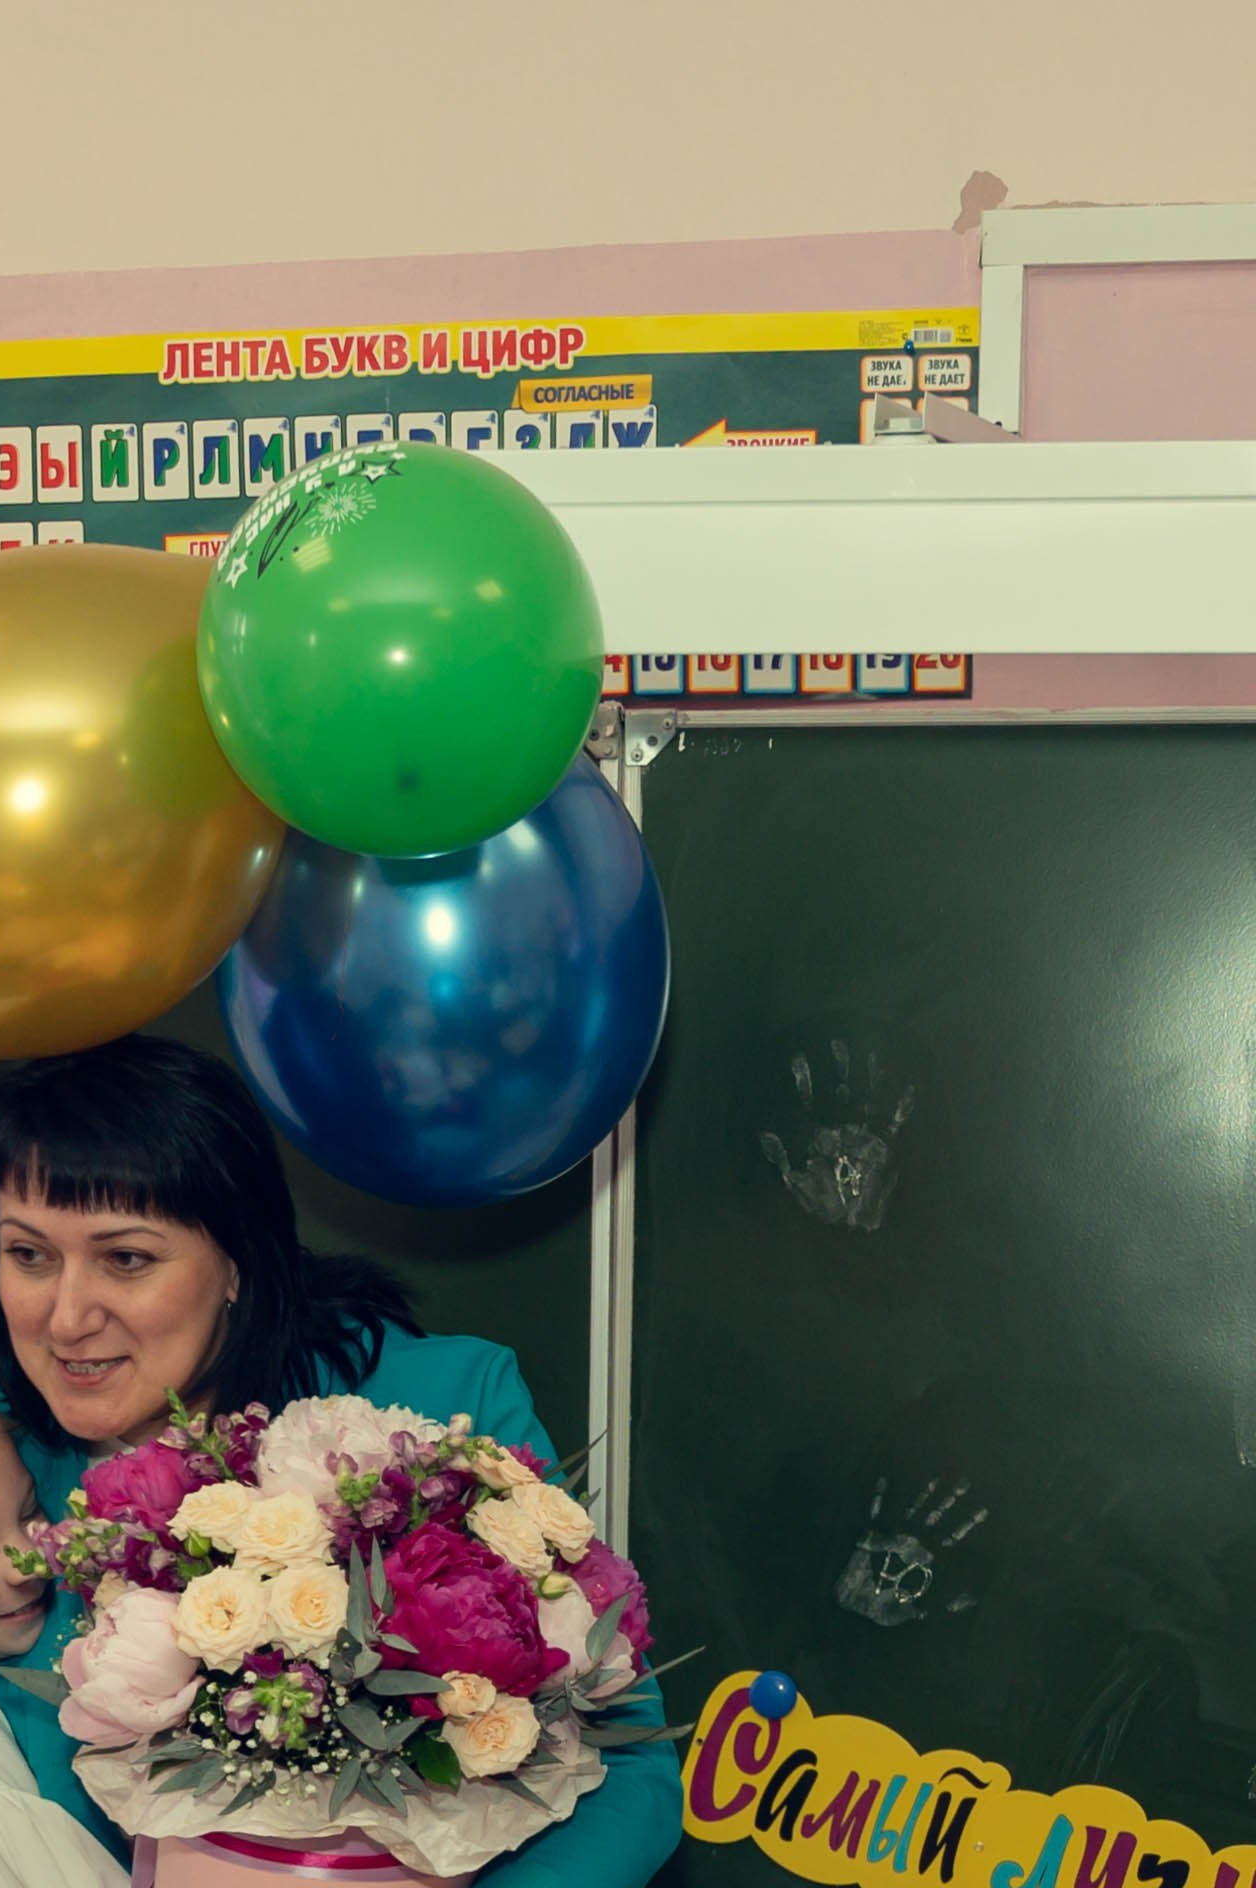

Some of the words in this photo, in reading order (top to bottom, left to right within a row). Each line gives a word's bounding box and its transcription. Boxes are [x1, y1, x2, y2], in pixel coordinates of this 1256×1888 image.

[162, 340, 292, 380] ЛЕНТА
[305, 334, 408, 375] БУКВ
[422, 332, 448, 369] И
[462, 328, 584, 374] ЦИФР
[871, 360, 902, 371] ЗВУКА
[928, 359, 959, 370] ЗВУКА
[867, 375, 880, 386] НЕ
[882, 375, 907, 387] ДАЕ
[924, 374, 937, 385] НЕ
[939, 373, 965, 386] ДАЕТ
[533, 383, 634, 403] СОГЛАСНЫЕ
[40, 441, 79, 488] Ы
[99, 429, 130, 488] Й
[152, 437, 180, 487] Р
[248, 433, 284, 483] М
